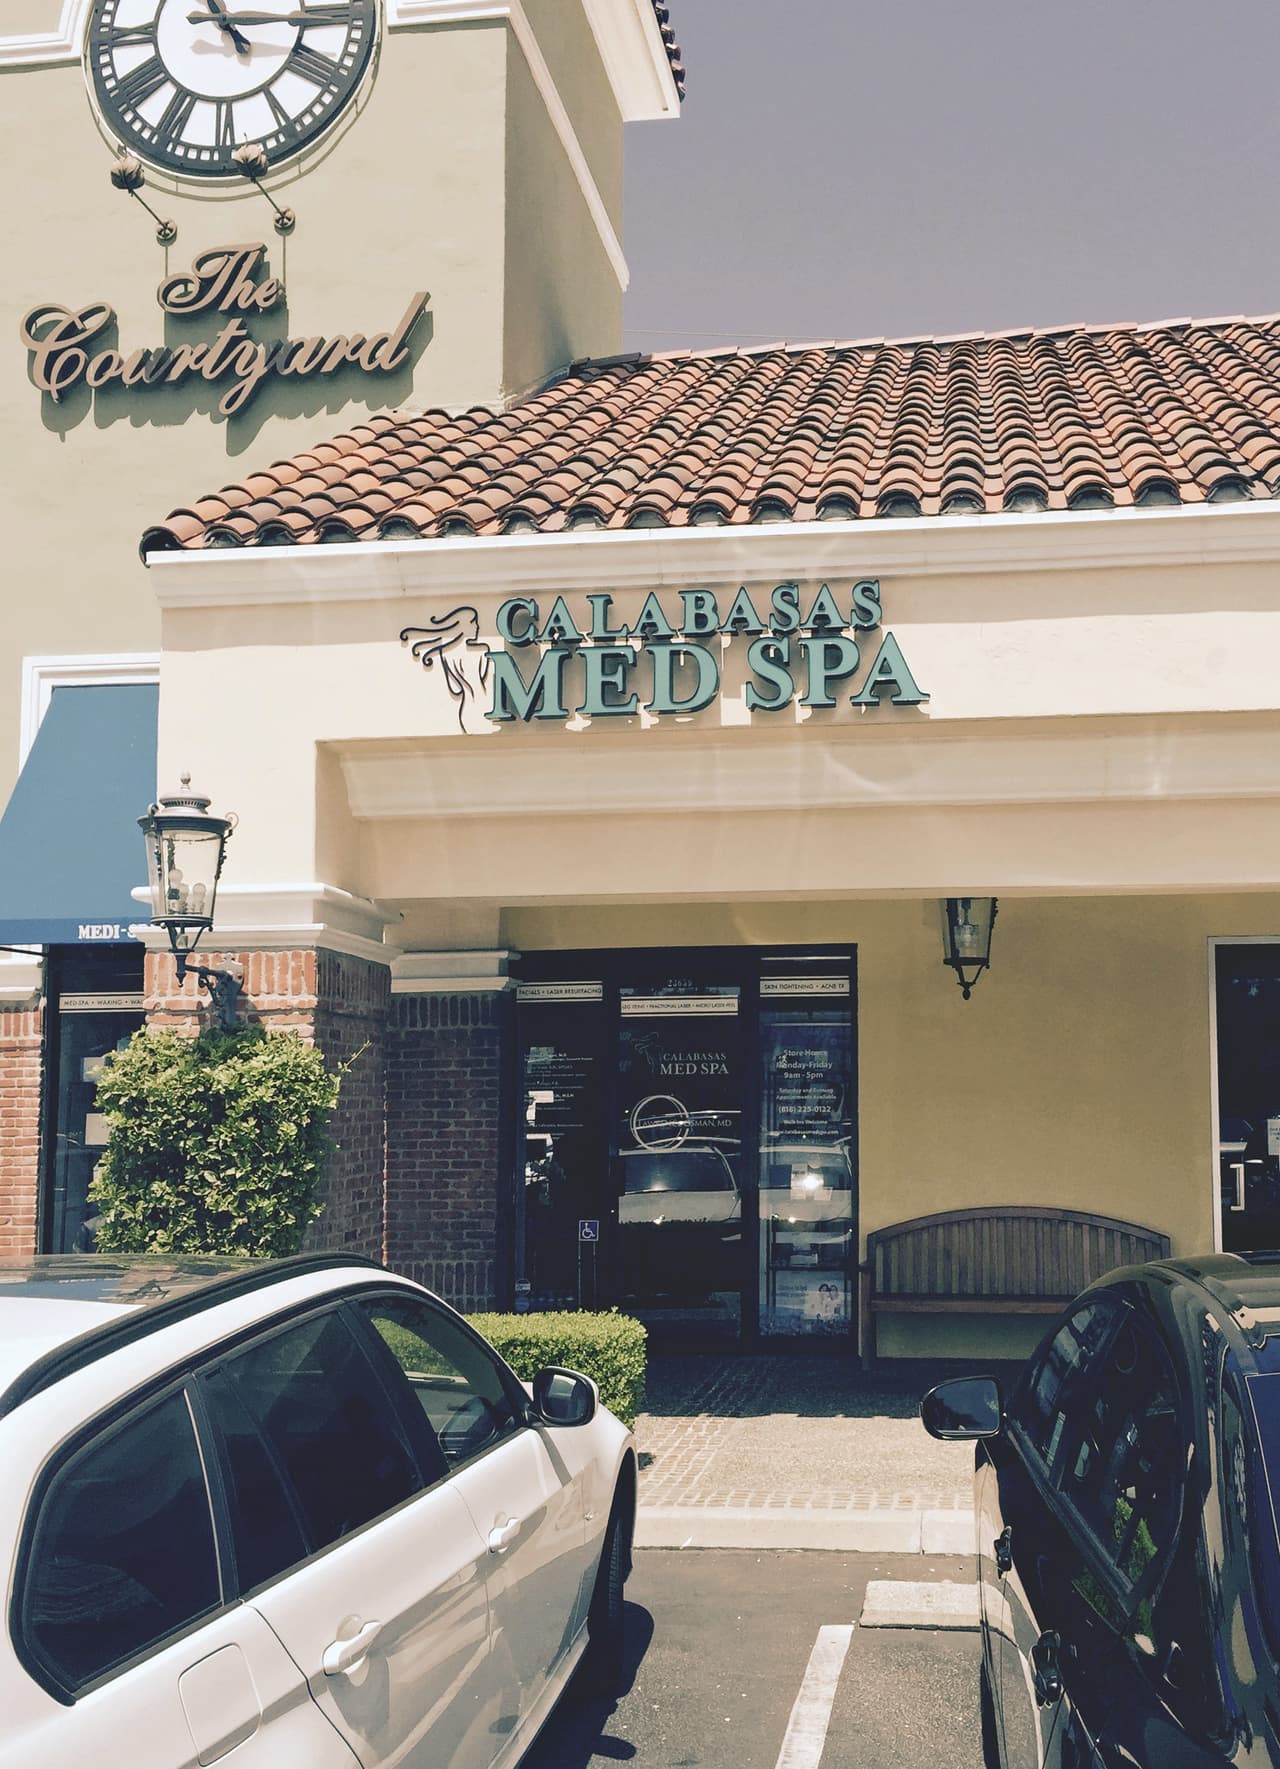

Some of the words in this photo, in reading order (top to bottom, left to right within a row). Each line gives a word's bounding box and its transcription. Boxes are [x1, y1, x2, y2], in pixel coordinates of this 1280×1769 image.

[157, 242, 279, 315] The
[20, 291, 431, 416] Courtyard
[496, 580, 883, 646] CALABASAS
[484, 643, 721, 722] MED
[746, 631, 931, 713] SPA
[78, 923, 154, 940] MEDI-S
[663, 1053, 727, 1061] CALABASAS
[783, 1049, 804, 1057] Store
[660, 1063, 697, 1075] MED
[701, 1063, 729, 1075] SPA
[806, 1072, 824, 1080] 5pm
[717, 1119, 733, 1127] MD
